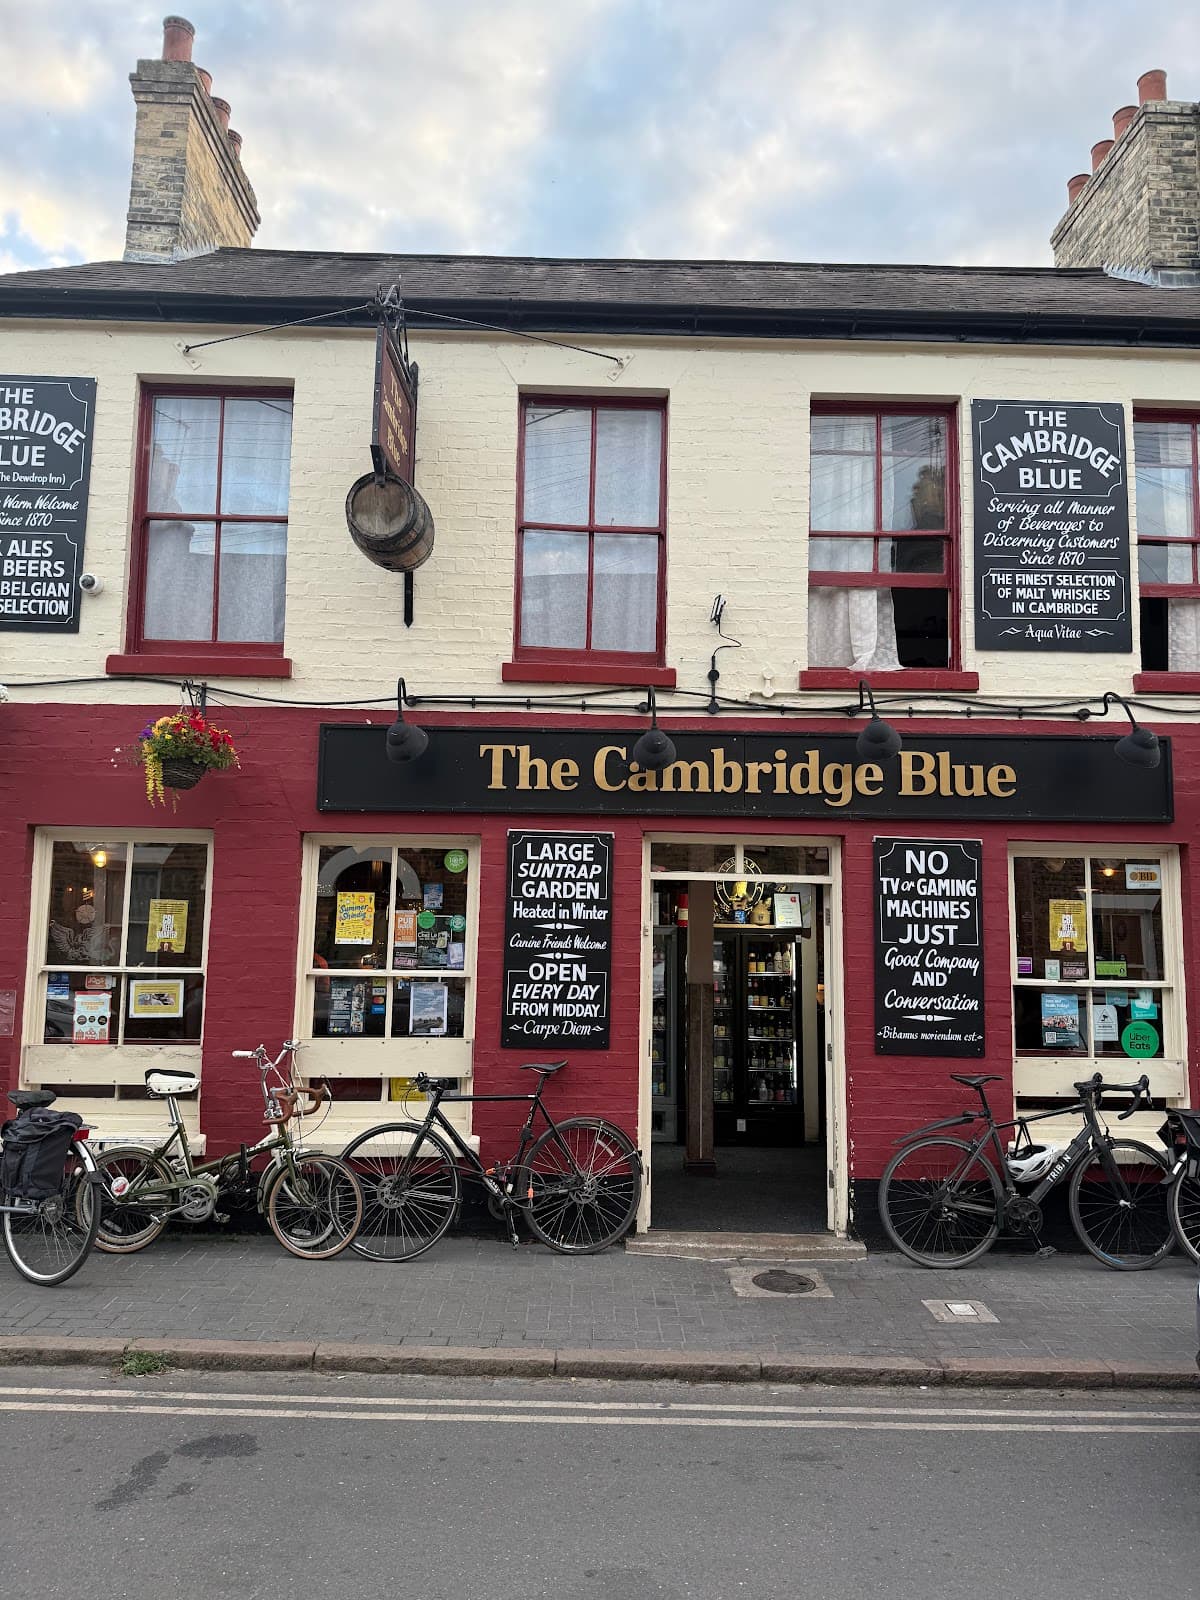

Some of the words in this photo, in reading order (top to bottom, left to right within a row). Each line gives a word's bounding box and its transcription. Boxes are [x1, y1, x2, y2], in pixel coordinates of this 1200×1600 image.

[1025, 410, 1068, 428] THE
[981, 429, 1121, 479] CAMBRIDGE
[12, 472, 48, 485] Dewdrop
[49, 473, 66, 485] Inn)
[1019, 467, 1083, 489] BLUE
[3, 494, 32, 509] Warm
[34, 494, 79, 510] Welcome
[987, 497, 1042, 518] Serving
[1043, 500, 1065, 514] all
[1066, 500, 1115, 515] Manner
[25, 512, 53, 526] 1870
[997, 516, 1015, 532] of
[1019, 517, 1085, 535] Beverages
[1088, 518, 1104, 532] to
[7, 540, 53, 557] ALES
[983, 532, 1056, 552] Discerning
[1058, 534, 1120, 549] Customers
[1020, 549, 1055, 565] Since
[1058, 551, 1085, 566] 1870
[3, 560, 65, 577] BEERS
[990, 573, 1013, 585] THE
[1015, 574, 1054, 586] FINEST
[1056, 574, 1116, 587] SELECTION
[0, 582, 70, 597] BELGIAN
[997, 587, 1012, 599] OF
[1016, 588, 1046, 600] MALT
[1051, 588, 1111, 601] WHISKIES
[1012, 602, 1025, 614] IN
[1028, 602, 1099, 615] CAMBRIDGE
[1024, 623, 1053, 643] Aqua
[1054, 623, 1082, 640] Vitae
[479, 744, 580, 791] The
[593, 745, 884, 807] Cambridge
[898, 751, 1017, 797] Blue
[526, 842, 595, 862] LARGE
[905, 850, 949, 875] NO
[518, 863, 602, 880] SUNTRAP
[521, 881, 600, 899] GARDEN
[880, 877, 900, 894] TV
[901, 879, 915, 891] or
[916, 879, 977, 897] GAMING
[340, 904, 368, 913] Summer
[513, 901, 556, 919] Heated
[559, 903, 570, 919] in
[572, 902, 608, 920] Winter
[886, 899, 971, 919] MACHINES
[509, 933, 541, 948] Canine
[542, 934, 572, 949] Friends
[573, 934, 607, 950] Welcome
[899, 923, 958, 946] JUST
[884, 946, 924, 970] Good
[924, 948, 980, 976] Company
[528, 963, 587, 982] OPEN
[911, 971, 948, 987] AND
[512, 984, 564, 999] EVERY
[567, 985, 600, 1000] DAY
[884, 989, 979, 1010] Conversation
[512, 1003, 549, 1016] FROM
[552, 1003, 600, 1018] MIDDAY
[523, 1020, 560, 1040] Carpe
[561, 1021, 592, 1035] Diem
[881, 1025, 918, 1040] Bibamus
[920, 1028, 962, 1041] moriendum
[1129, 1032, 1151, 1041] Uber
[1129, 1041, 1151, 1050] Eats
